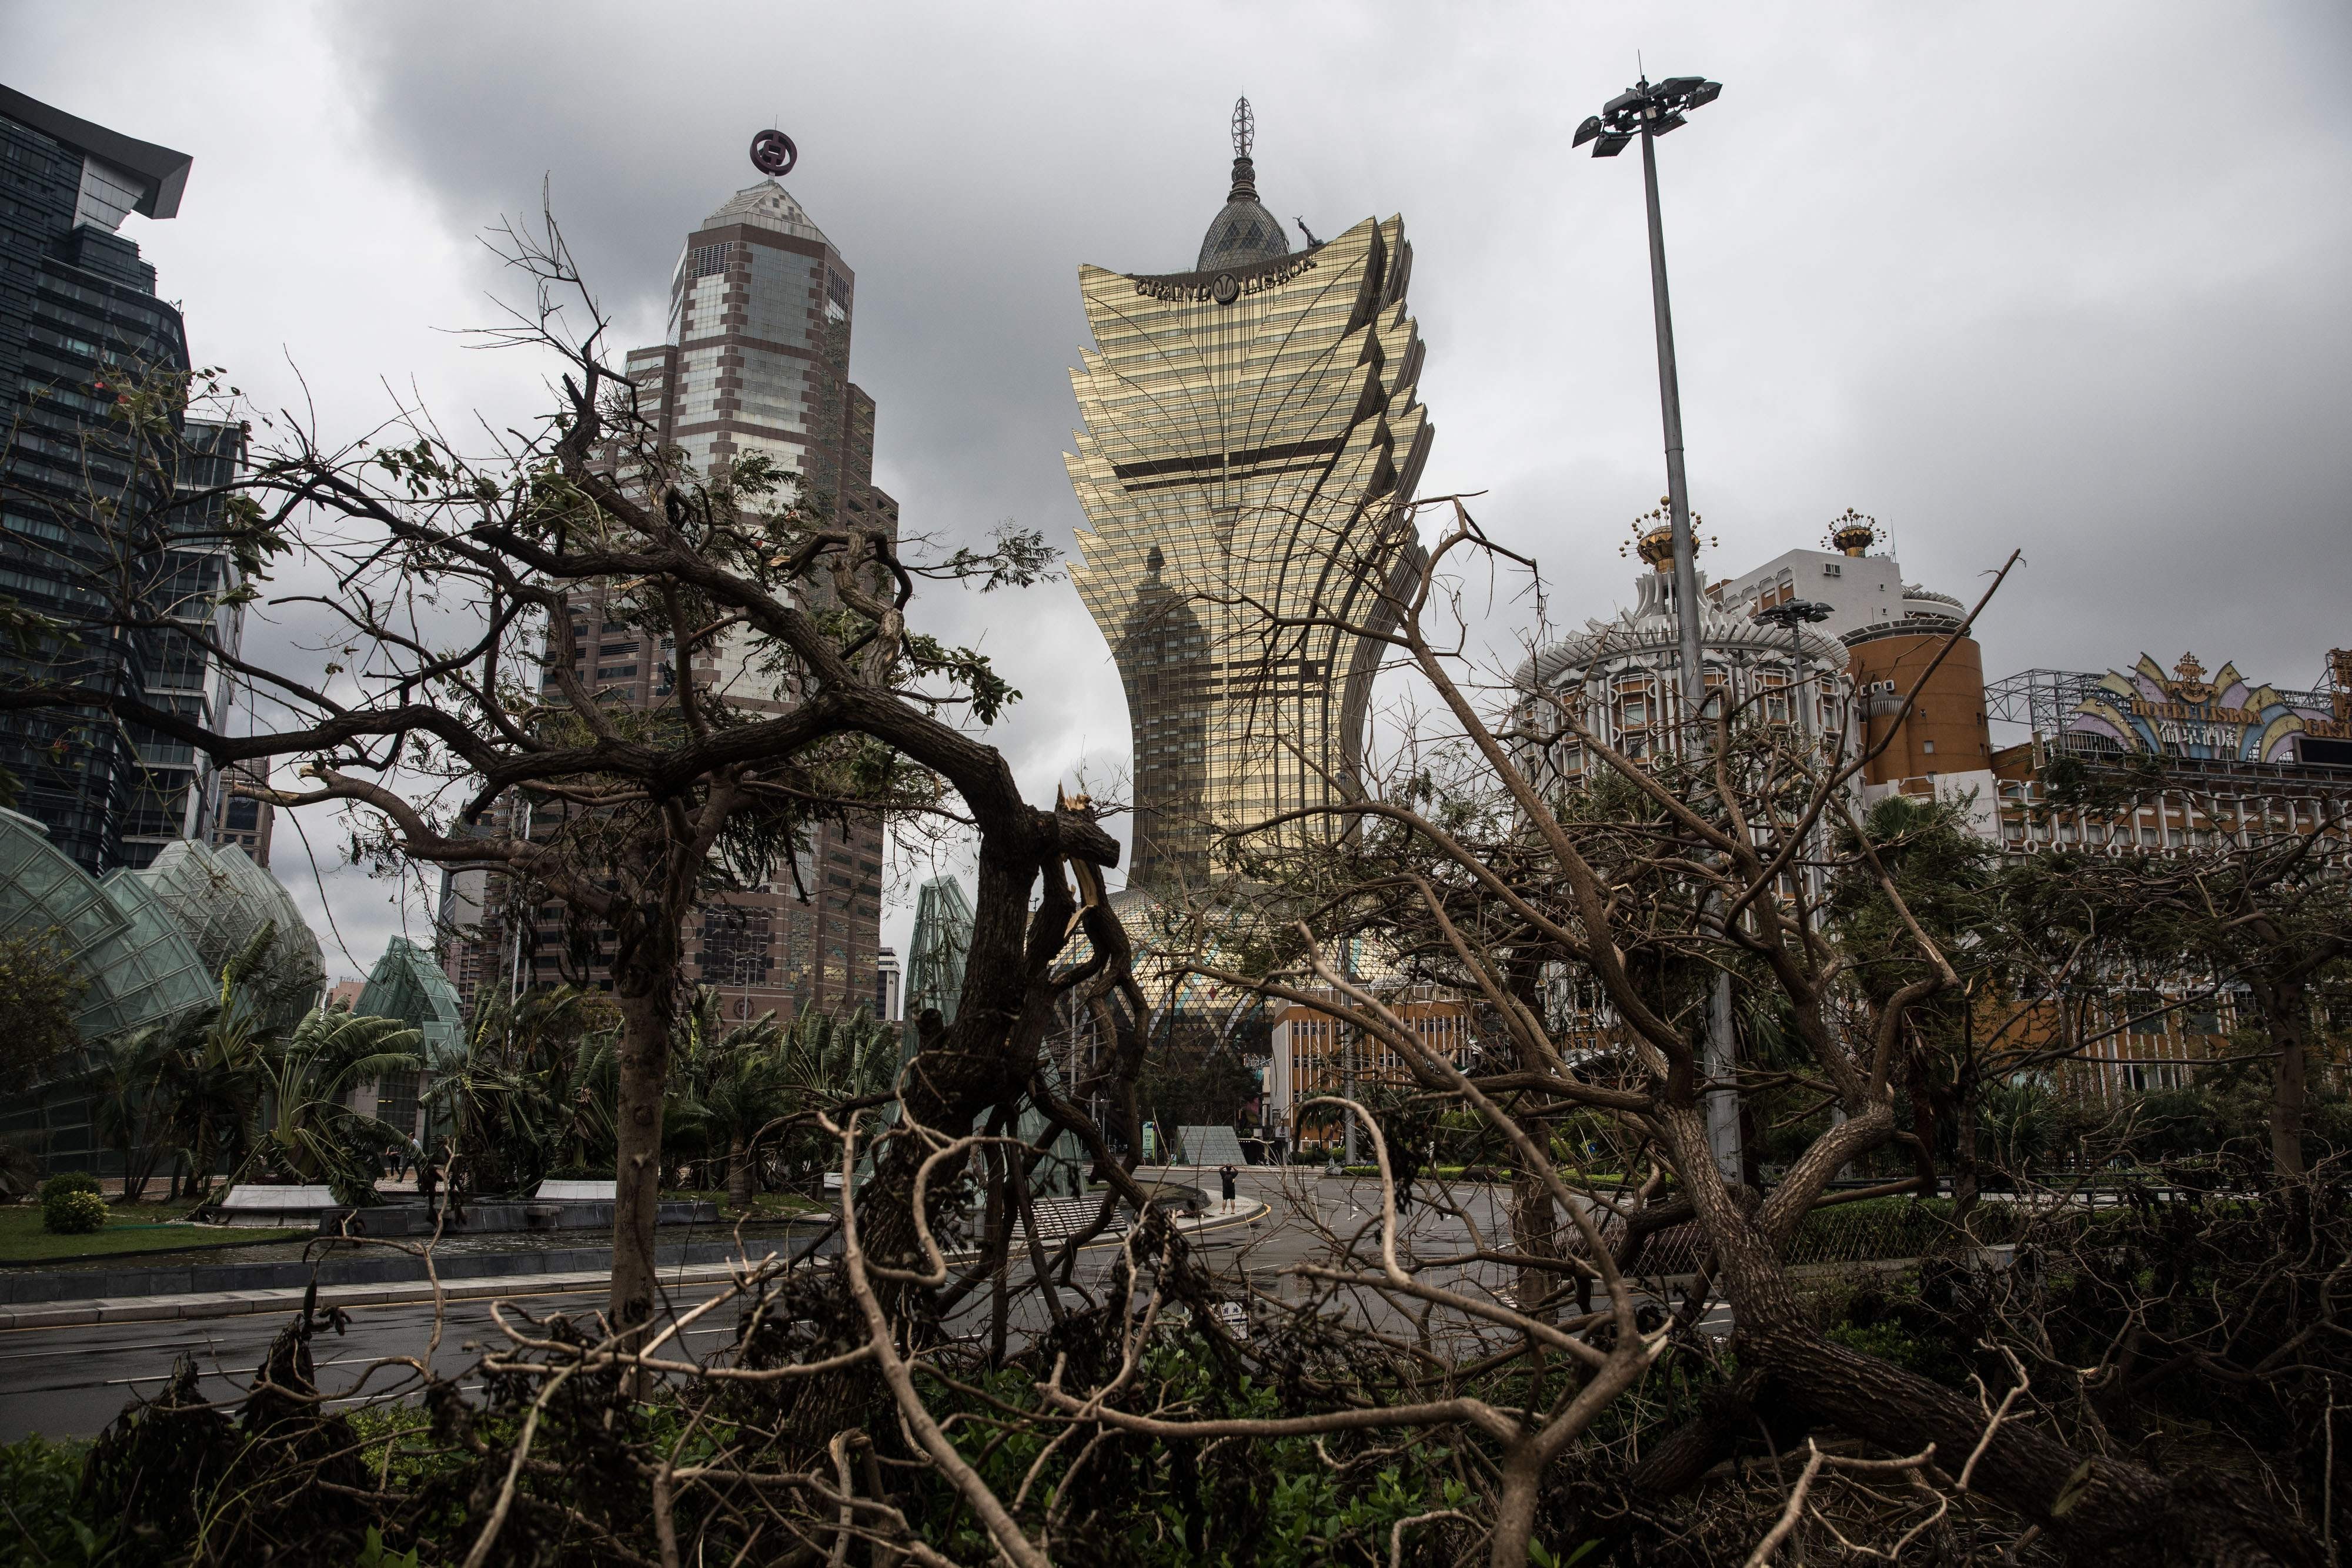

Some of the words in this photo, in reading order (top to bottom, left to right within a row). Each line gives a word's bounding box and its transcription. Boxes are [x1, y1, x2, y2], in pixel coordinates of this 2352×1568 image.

[1134, 278, 1212, 302] GRAND
[1241, 254, 1318, 295] LISBOA
[2130, 700, 2197, 719] HOTEL
[2199, 705, 2266, 724] LISBOA
[2159, 719, 2239, 748] 葡京酒店
